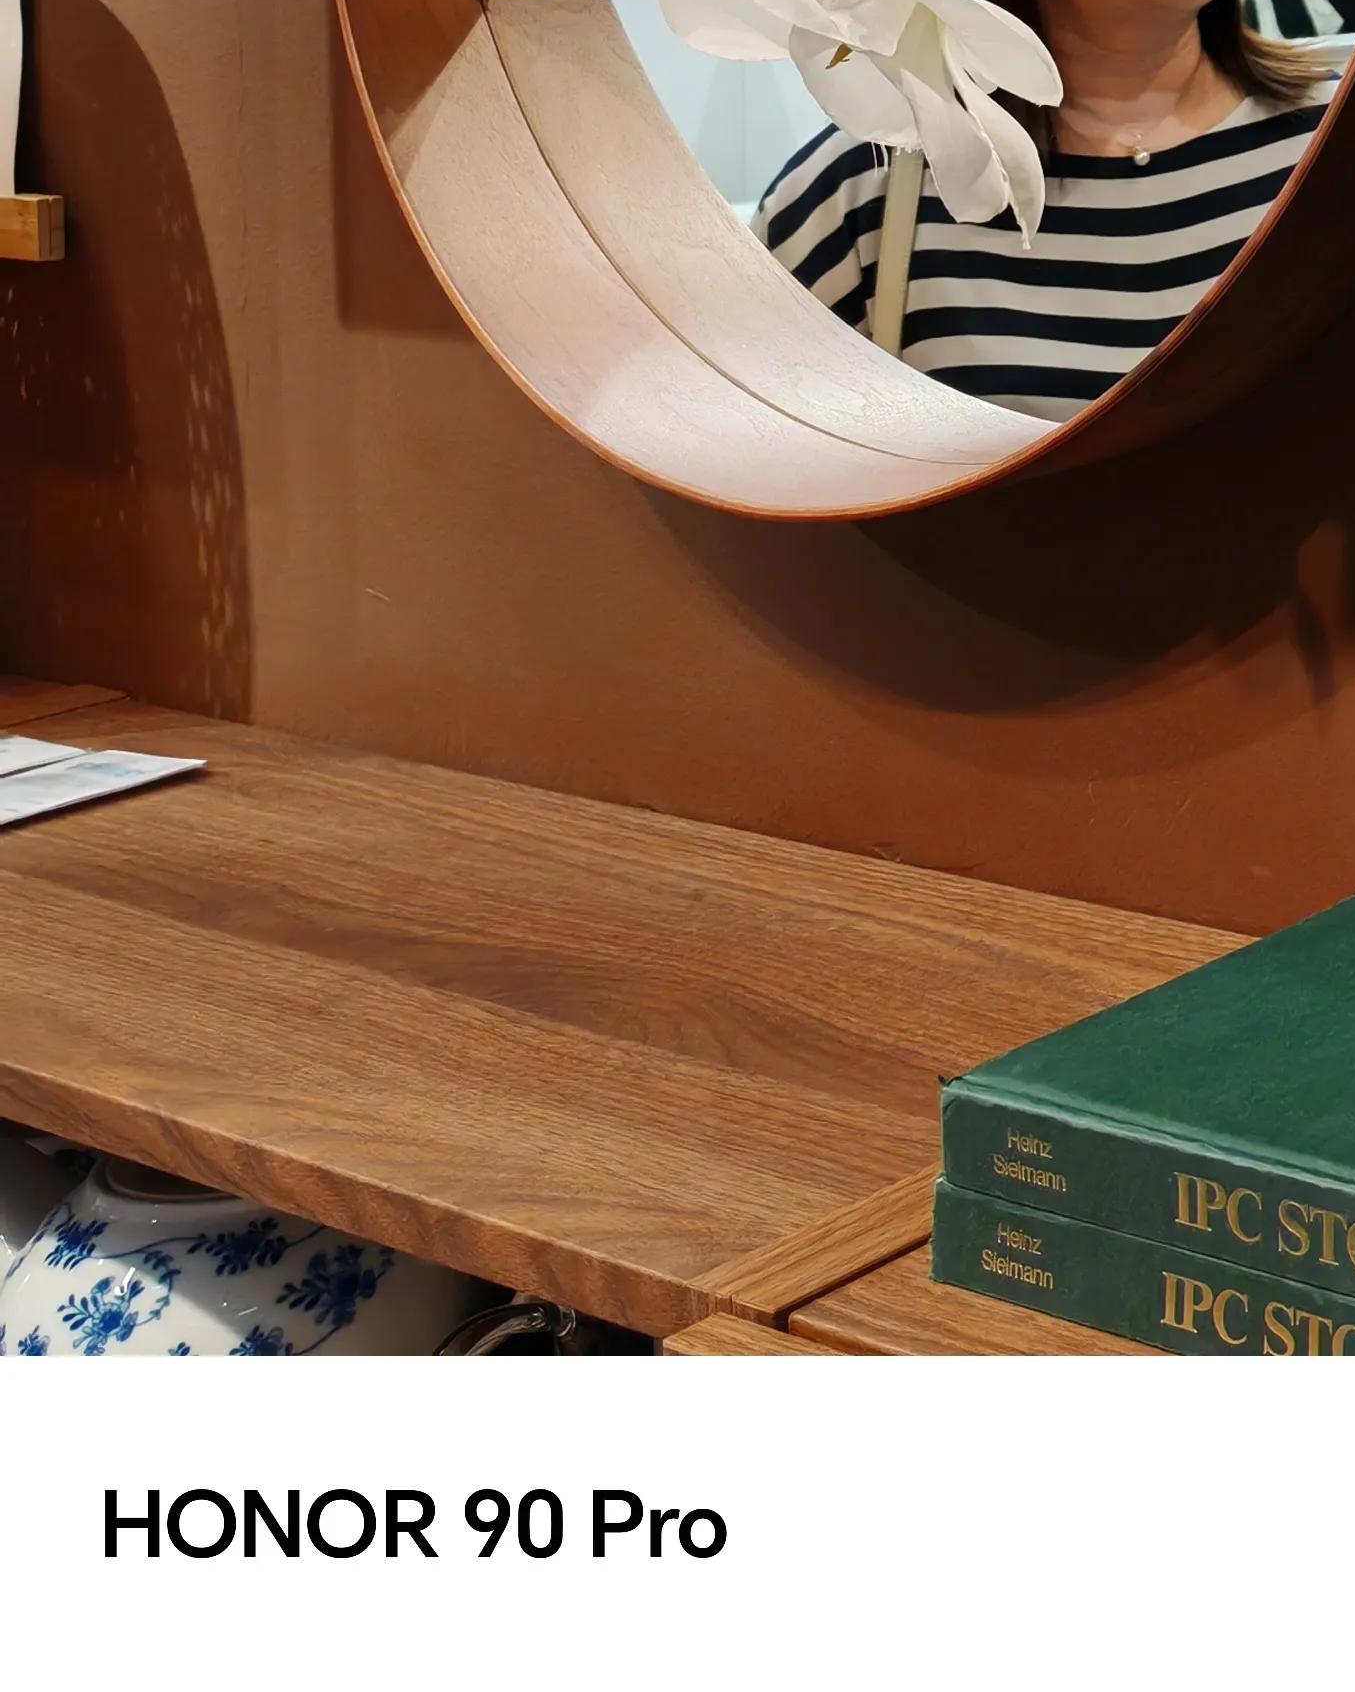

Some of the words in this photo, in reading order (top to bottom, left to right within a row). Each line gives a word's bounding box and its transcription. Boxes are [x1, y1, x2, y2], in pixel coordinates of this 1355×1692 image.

[1007, 1128, 1053, 1159] Heinz
[993, 1154, 1067, 1192] Sielmann
[1173, 1172, 1263, 1243] IPC
[997, 1223, 1042, 1255] Heinz
[981, 1249, 1054, 1290] Sielmann
[1160, 1271, 1249, 1345] IPC
